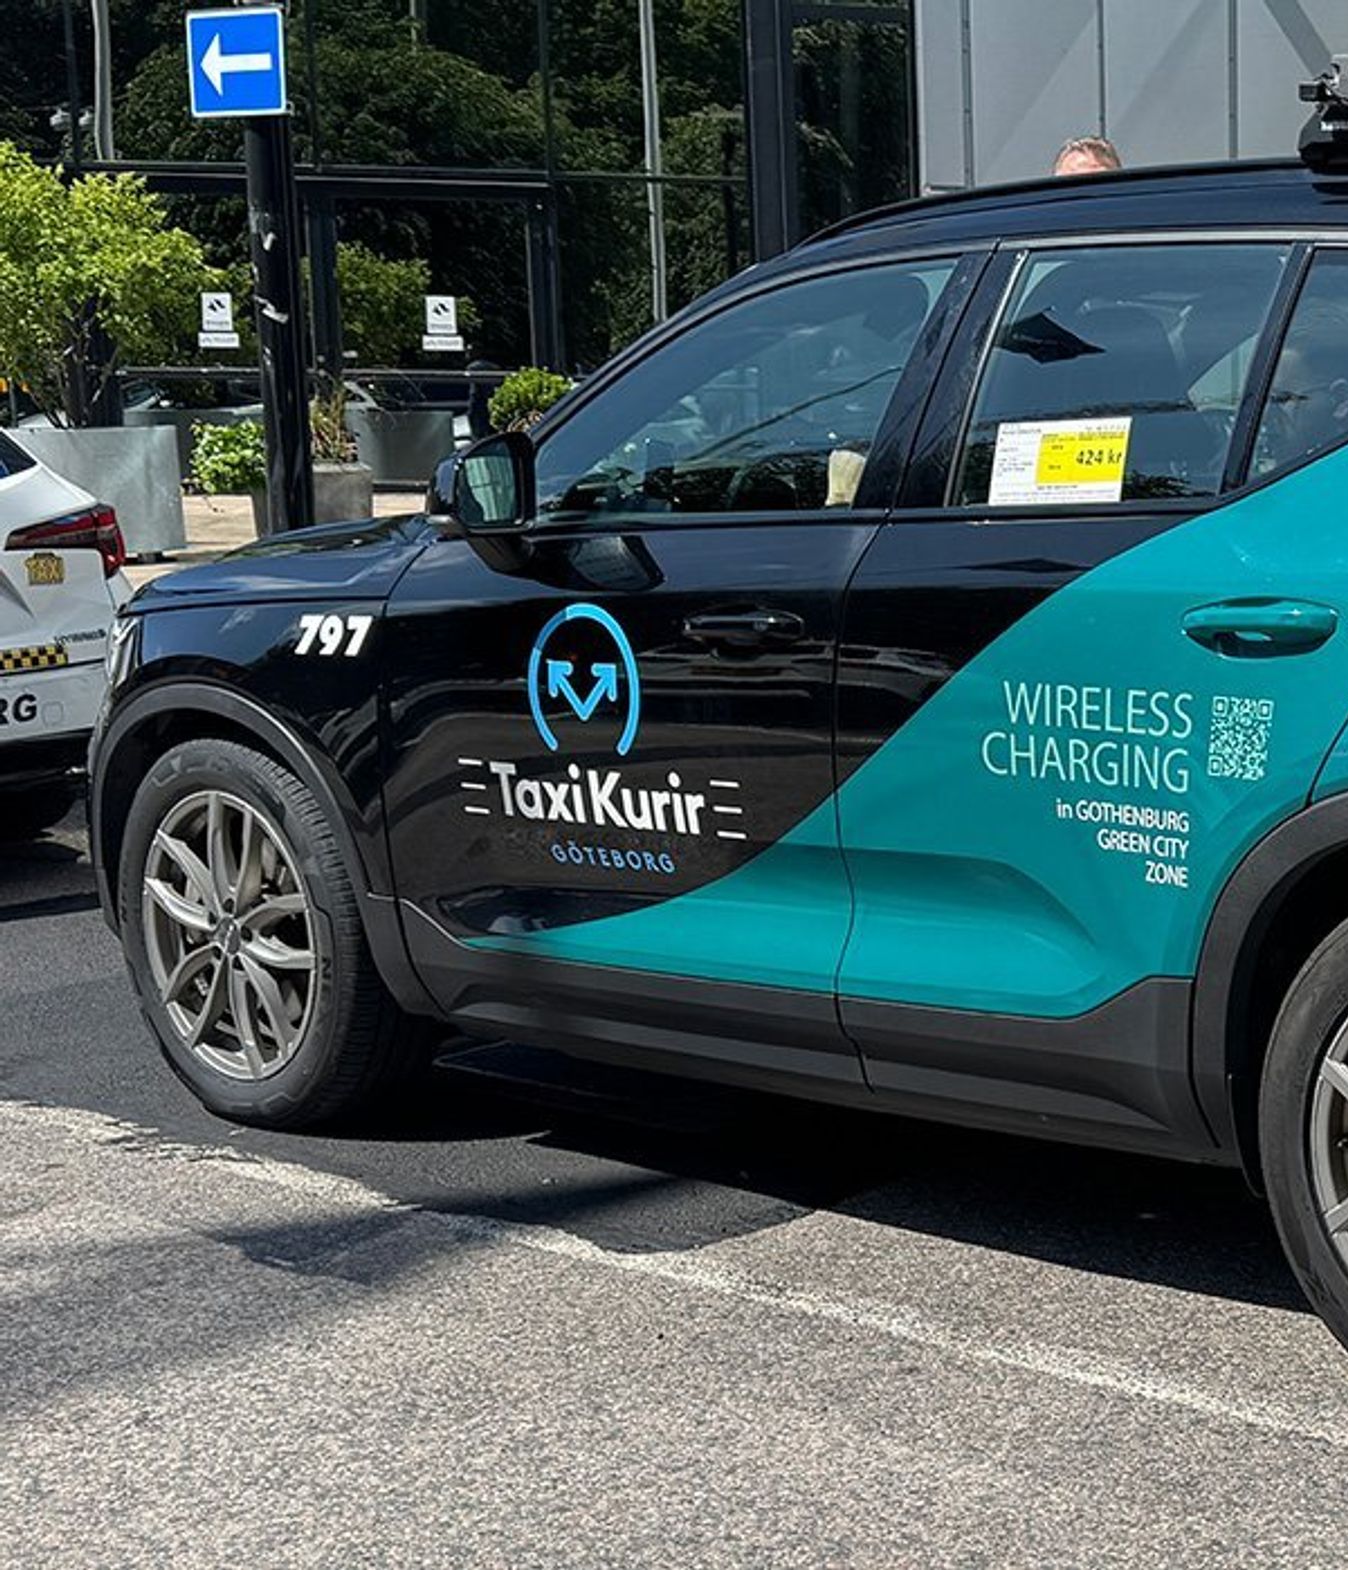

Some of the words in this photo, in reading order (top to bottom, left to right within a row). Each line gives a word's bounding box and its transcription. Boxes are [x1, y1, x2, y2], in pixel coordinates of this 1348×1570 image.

[1076, 449, 1104, 466] 424
[1107, 449, 1122, 464] kr
[294, 614, 374, 657] 797
[1003, 680, 1193, 738] WIRELESS
[982, 732, 1189, 793] CHARGING
[1056, 798, 1073, 818] in
[1076, 800, 1189, 833] GOTHENBURG
[551, 841, 674, 873] GÖTEBORG
[1097, 829, 1149, 855] GREEN
[1153, 835, 1189, 859] CITY
[1145, 861, 1188, 888] ZONE
